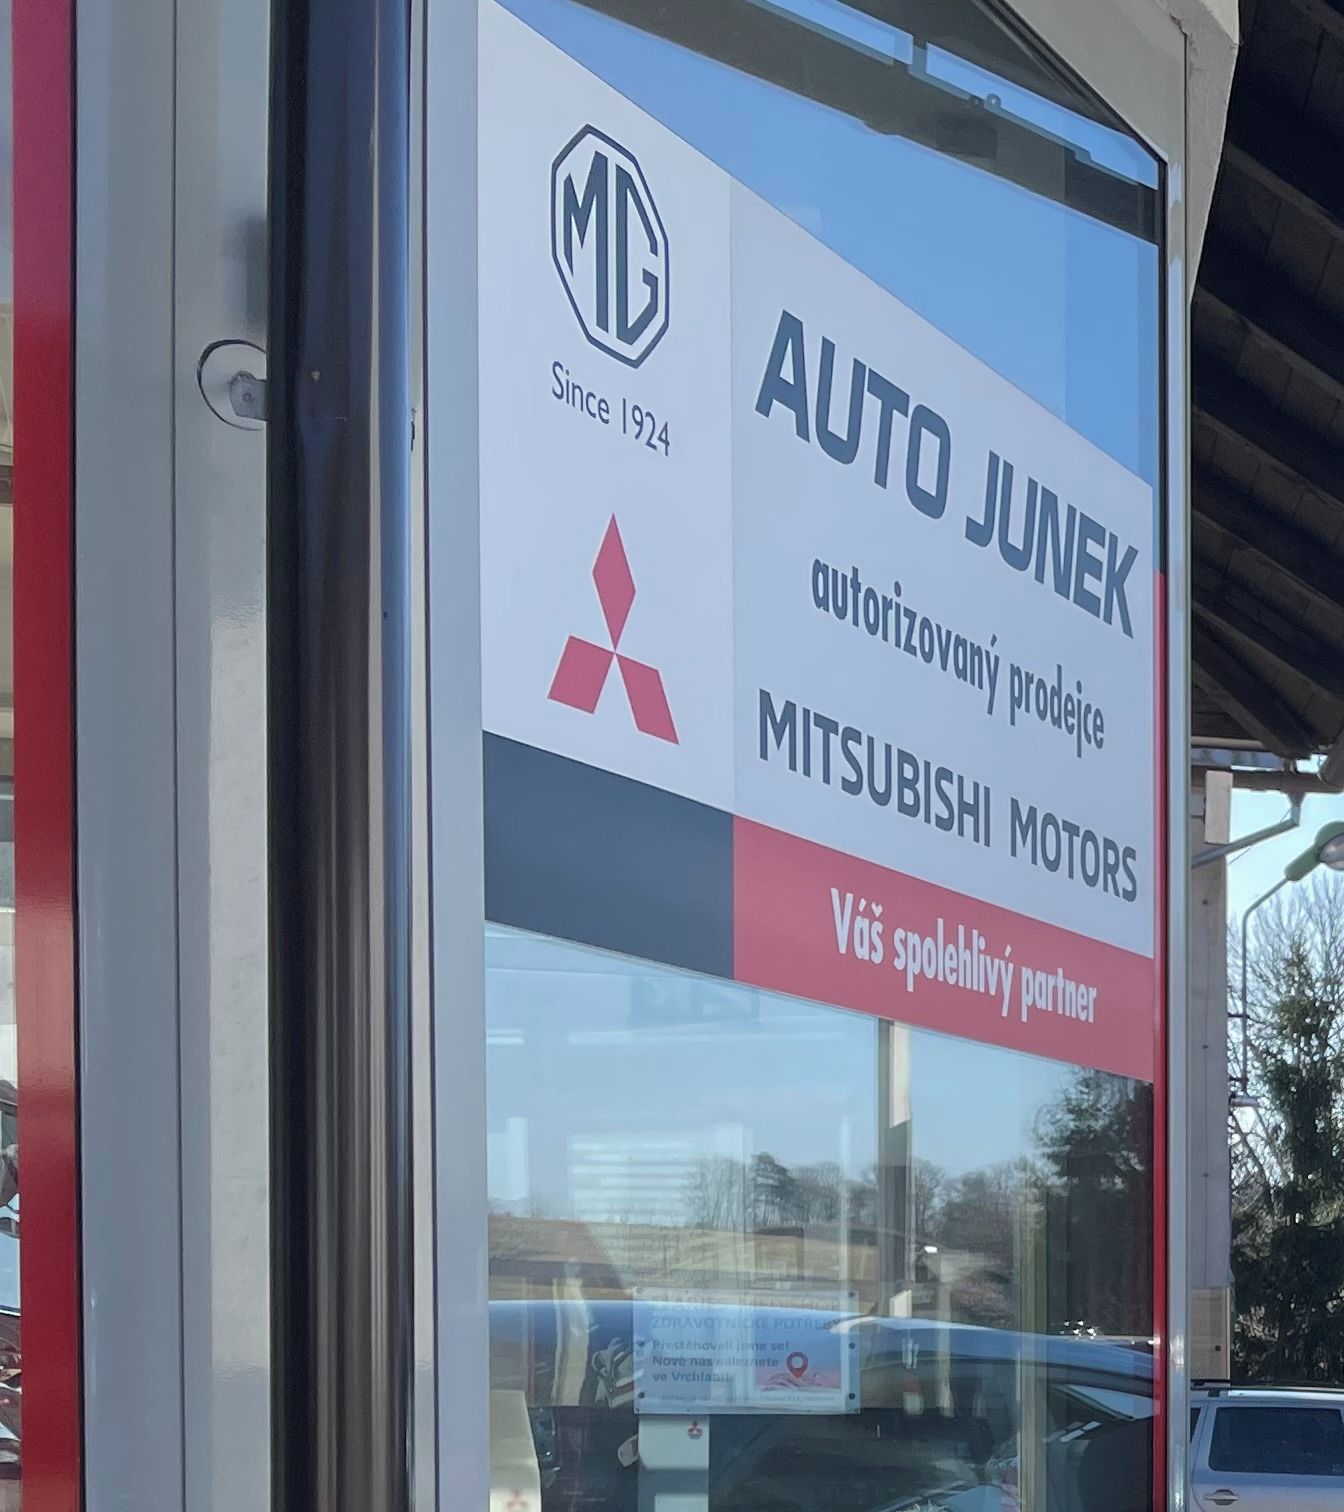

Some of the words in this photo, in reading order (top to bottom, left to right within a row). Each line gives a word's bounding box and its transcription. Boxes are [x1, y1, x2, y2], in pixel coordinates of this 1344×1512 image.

[563, 150, 660, 345] MG
[551, 361, 610, 425] Since
[621, 398, 671, 457] 1924
[754, 308, 951, 520] AUTO
[964, 449, 1139, 639] JUNEK
[811, 557, 1000, 715] autorizovaný
[1009, 662, 1105, 758] prodejce
[758, 688, 991, 848] MITSUBISHI
[1010, 797, 1137, 903] MOTORS
[830, 886, 884, 964] Váš
[893, 917, 1013, 1018] spolehlivý
[1021, 969, 1097, 1024] partner
